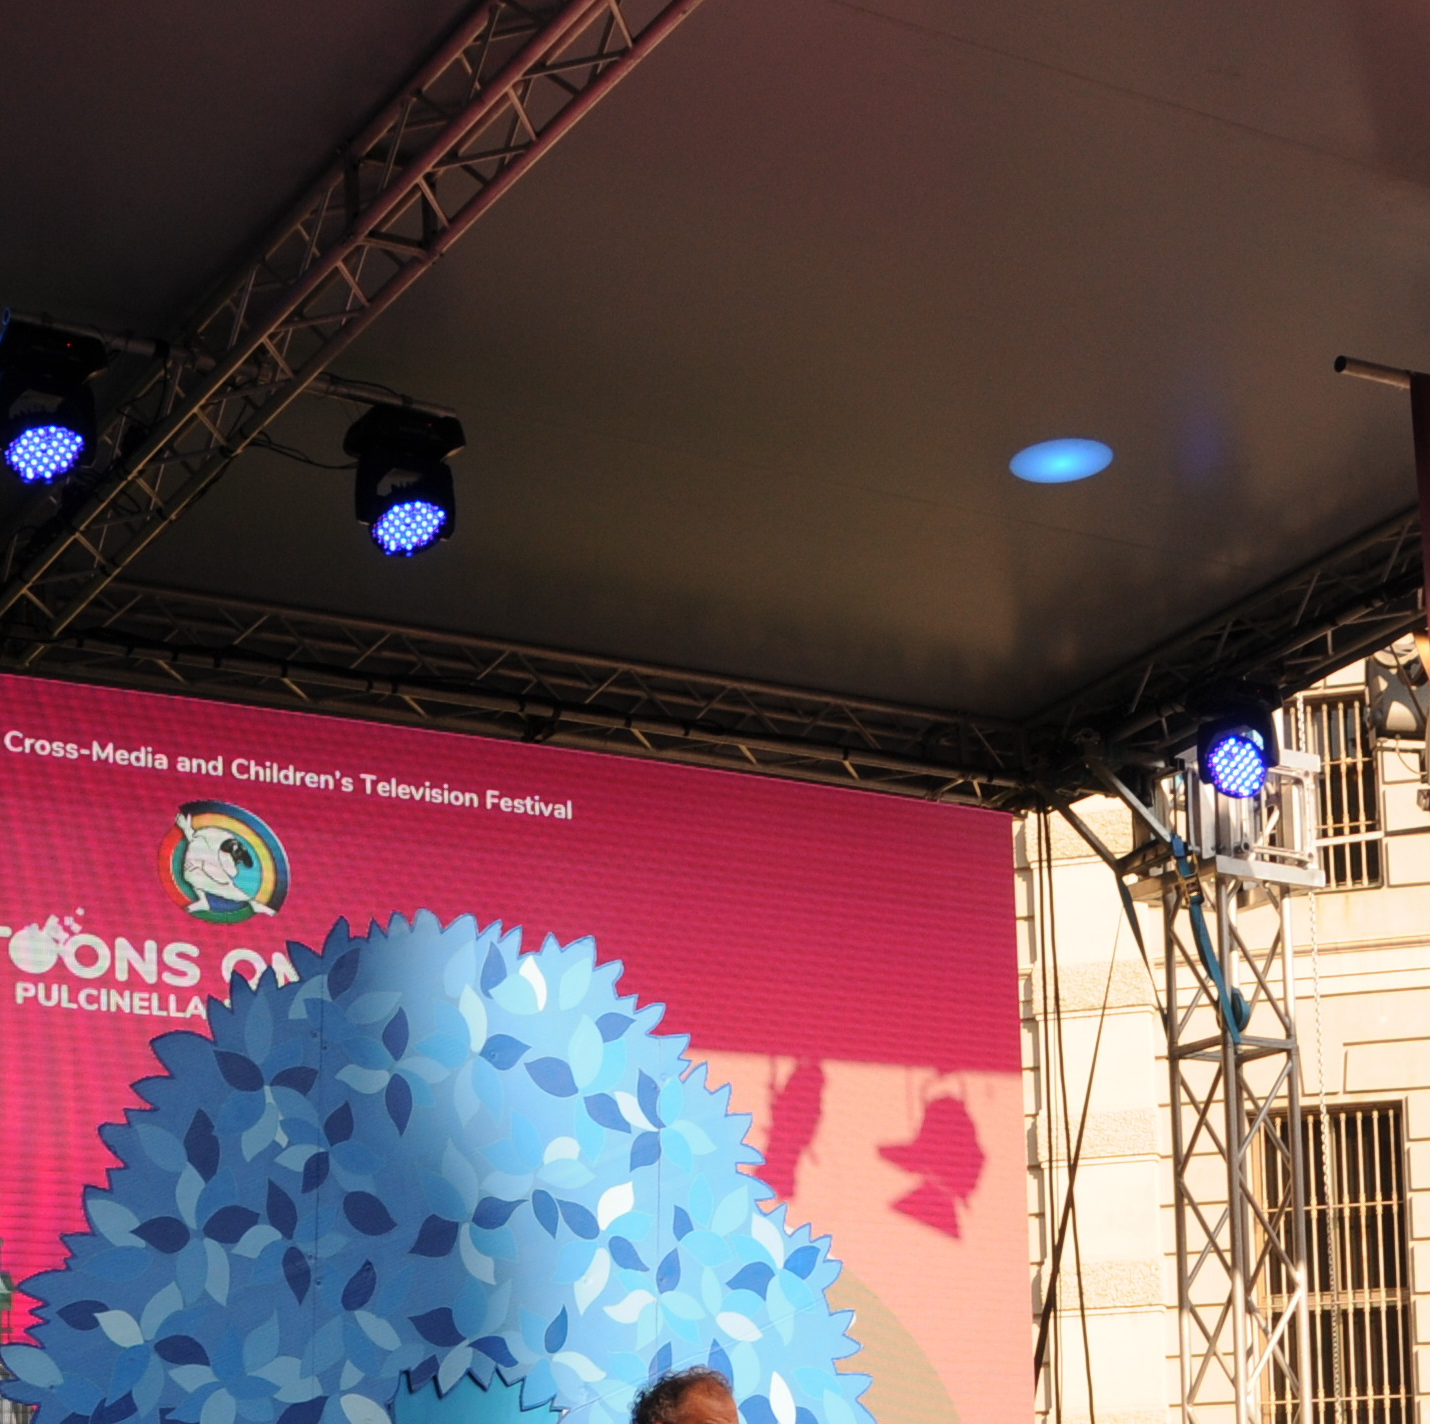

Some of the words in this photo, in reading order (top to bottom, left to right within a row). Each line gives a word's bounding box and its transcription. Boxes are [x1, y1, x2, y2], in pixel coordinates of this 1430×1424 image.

[3, 730, 168, 770] Cross-Media
[176, 755, 224, 777] and
[231, 758, 354, 792] Children's
[359, 774, 479, 807] Television
[485, 790, 573, 820] Festival
[15, 981, 207, 1020] PULCINELLA
